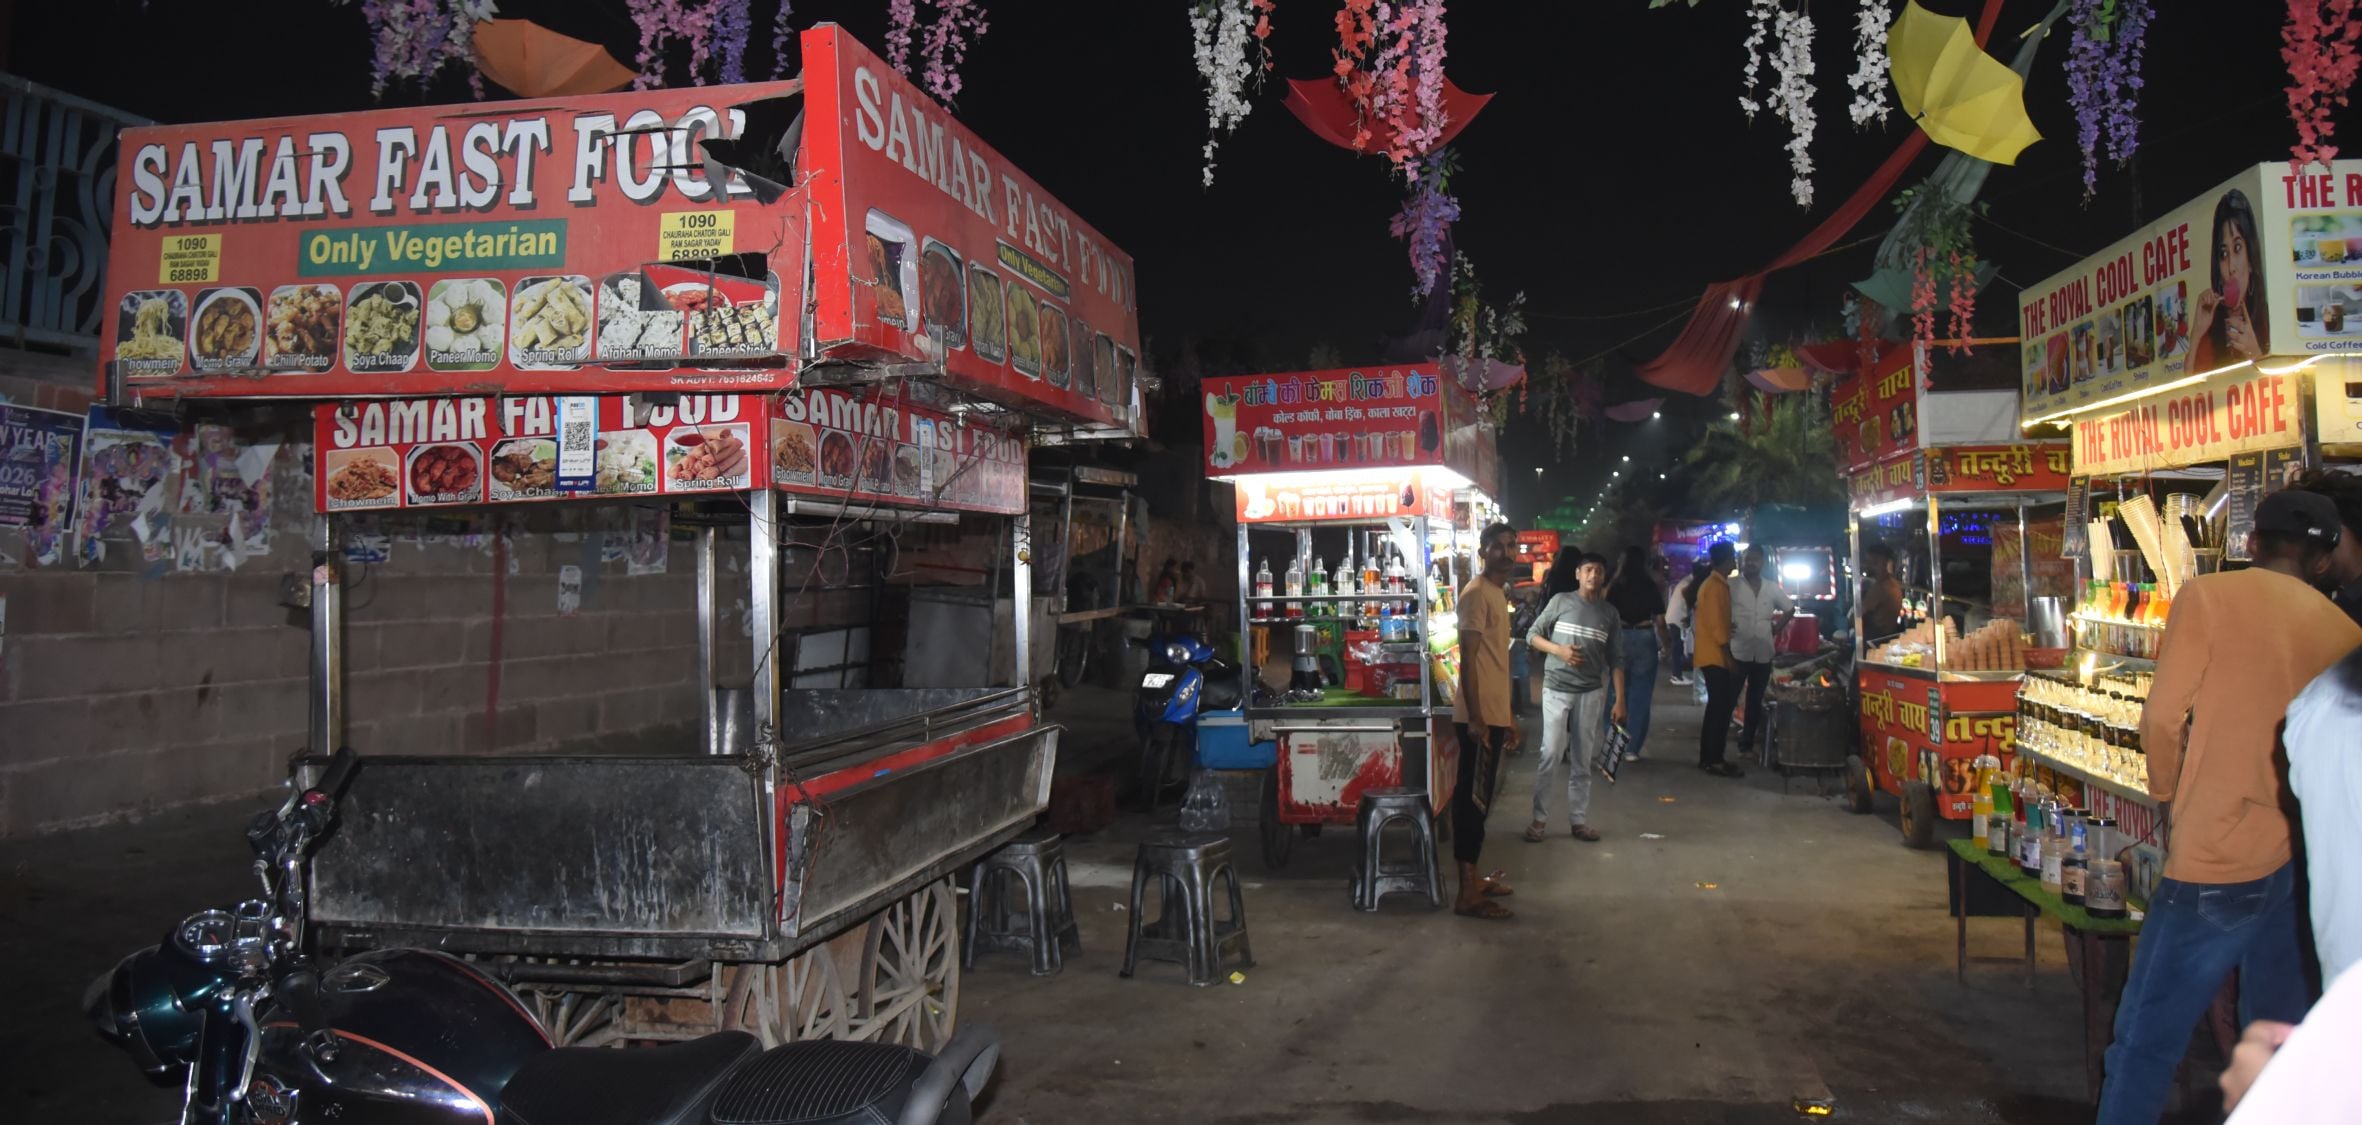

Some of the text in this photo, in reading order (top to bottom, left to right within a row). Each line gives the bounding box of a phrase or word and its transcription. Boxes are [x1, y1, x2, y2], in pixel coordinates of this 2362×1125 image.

[130, 131, 352, 227] SAMAR
[370, 116, 549, 213] FAST
[855, 66, 996, 225] SAMAR
[1002, 173, 1071, 273] FAST
[2282, 174, 2336, 209] THE
[680, 214, 717, 228] 1090
[663, 228, 731, 239] CHAURAHA CHATORI GALI
[177, 237, 208, 250] 1090
[309, 226, 557, 270] Only Vegetarian
[671, 238, 722, 248] RAM SAGAR YADAV
[1001, 246, 1020, 270] Only
[170, 268, 208, 282] 68898
[2023, 223, 2191, 342] THE ROYAL COOL CAFE
[2296, 272, 2331, 280] Korean
[521, 346, 578, 363] Spring Roll
[601, 345, 677, 359] Afghani Momo
[699, 343, 767, 356] Paneer Stick
[2305, 342, 2328, 350] Cold
[274, 354, 329, 367] Chilli Potato
[352, 351, 409, 369] Soya Chaap
[430, 349, 497, 364] Paneer Momo
[1280, 376, 1302, 404] की
[1305, 375, 1347, 403] फेमस
[1349, 370, 1404, 401] शिकंजी
[1407, 369, 1438, 399] शेक
[1877, 365, 1911, 399] चाय
[334, 396, 487, 449] SAMAR
[503, 396, 558, 438] FA
[785, 389, 900, 441] SAMAR
[1272, 409, 1295, 423] कोल्ड
[1367, 407, 1391, 418] काला
[2080, 375, 2287, 466] THE ROYAL COOL CAFE
[1957, 444, 2034, 485] तन्दूरी
[2045, 450, 2069, 474] च
[776, 465, 813, 482] Chowmein
[1856, 464, 1884, 498] तन्दूरी
[1888, 460, 1912, 486] चाय
[623, 482, 655, 492] Momo
[675, 477, 739, 489] Spring Roll
[332, 497, 394, 508] Chowmein
[437, 493, 455, 502] With
[458, 491, 482, 503] Gravy
[491, 489, 522, 500] Soya
[1860, 688, 1894, 731] तन्दूरी
[1897, 700, 1927, 734] चाय
[1930, 718, 1940, 743] 39
[2087, 783, 2109, 819] THE
[2114, 793, 2157, 848] ROYAL
